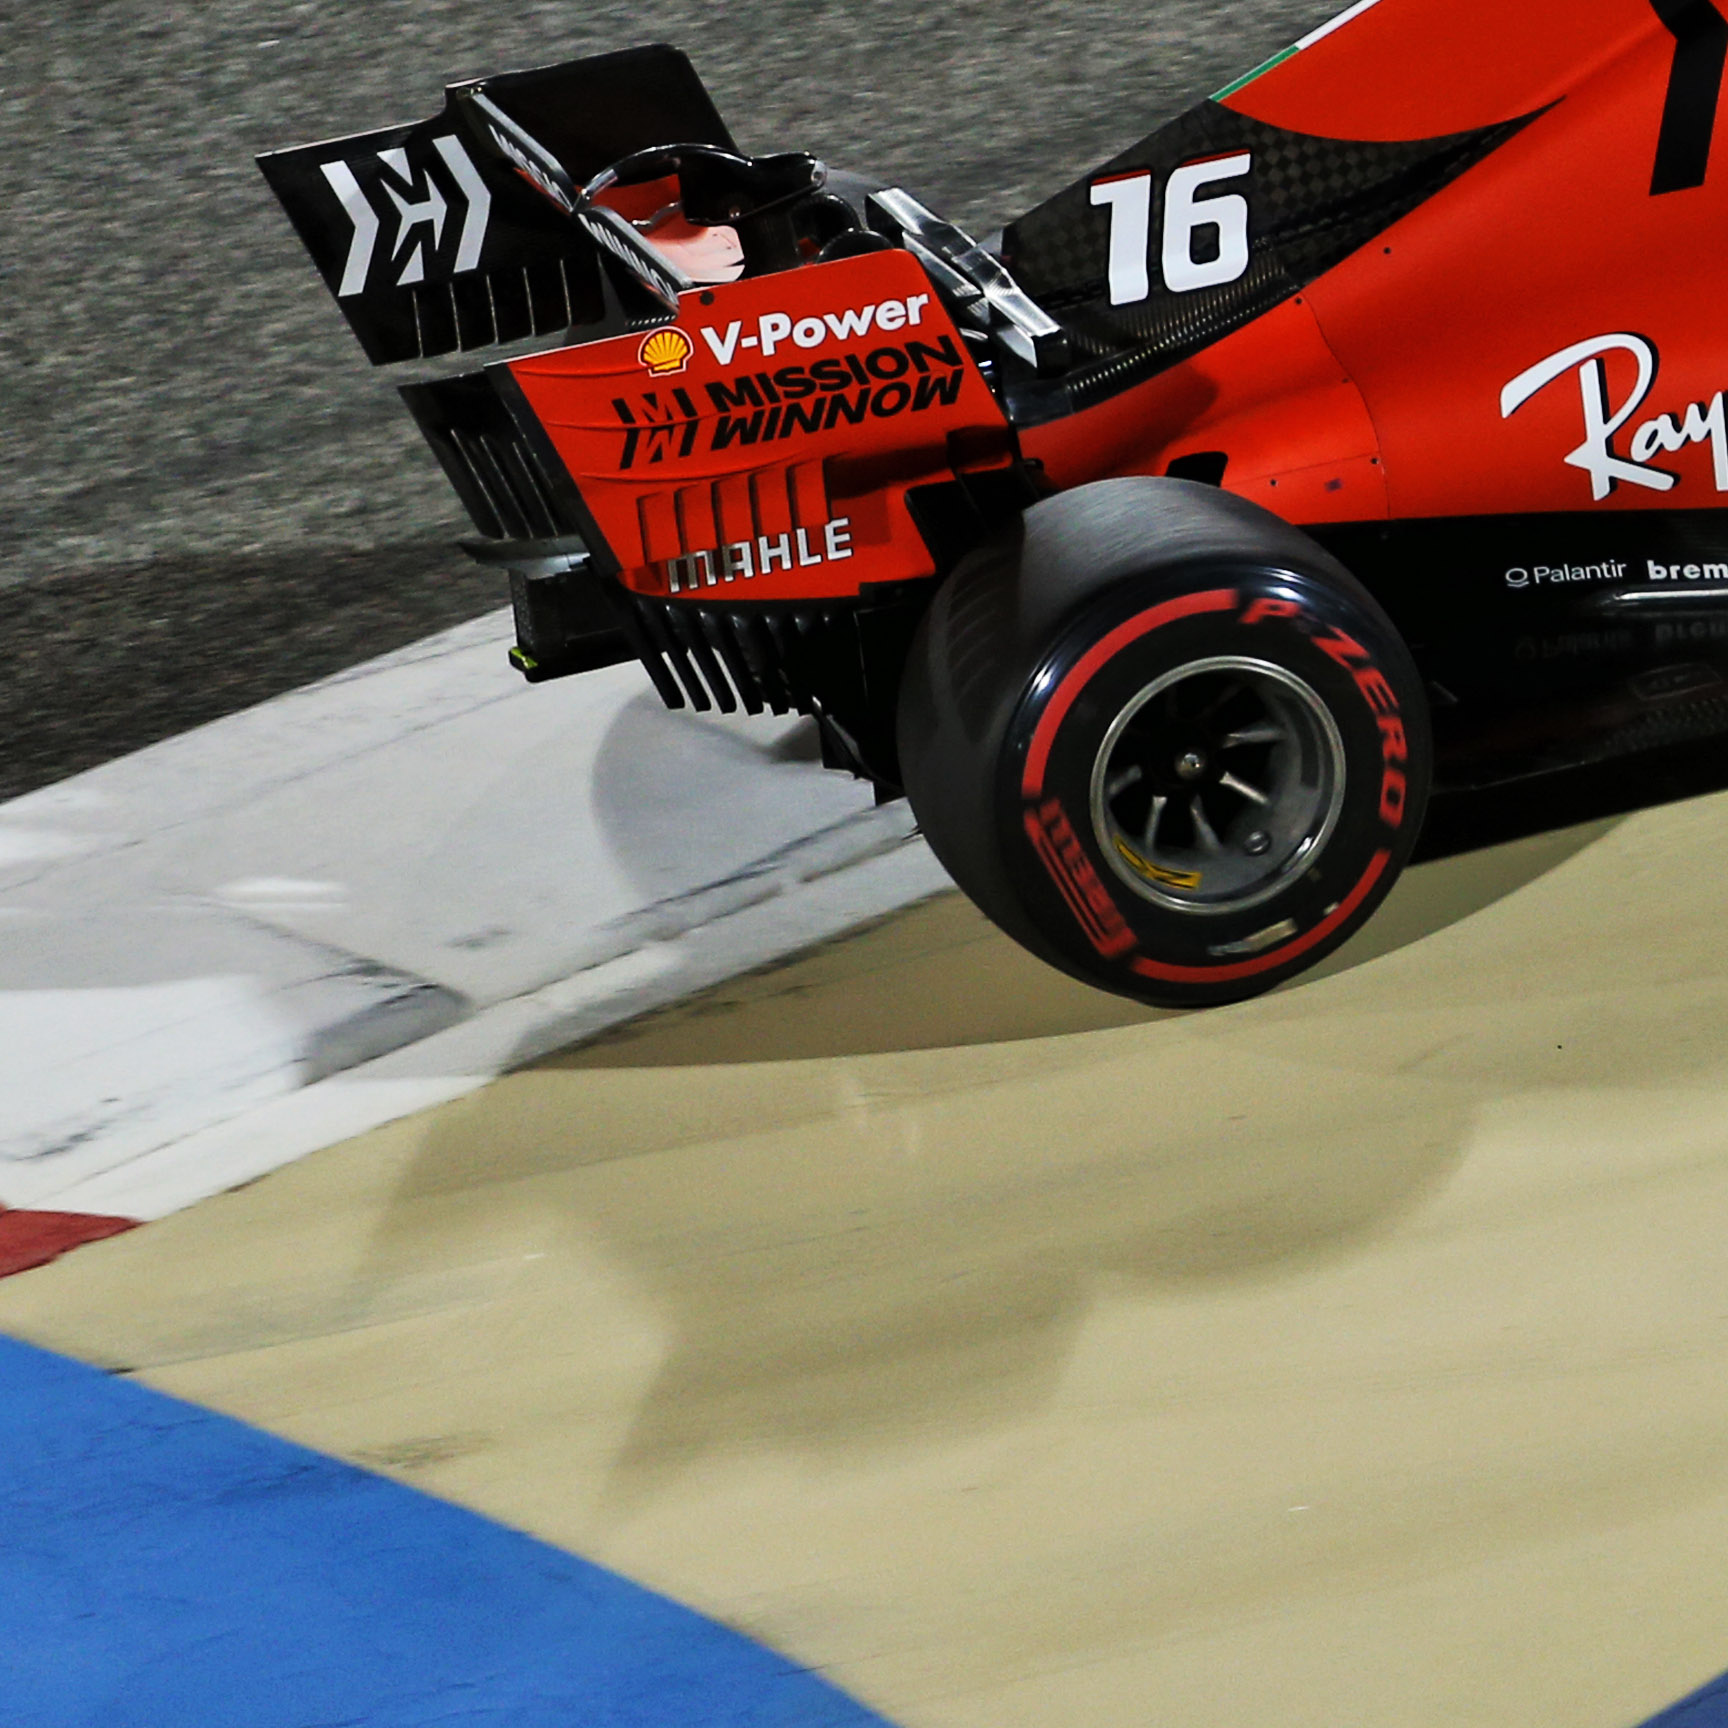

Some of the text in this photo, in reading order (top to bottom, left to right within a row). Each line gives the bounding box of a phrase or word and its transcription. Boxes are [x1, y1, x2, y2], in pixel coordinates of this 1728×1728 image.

[1090, 151, 1251, 306] 16
[700, 293, 930, 365] V-Power
[705, 335, 964, 412] MISSION
[711, 368, 964, 451] WINNOW
[667, 518, 852, 593] MAHLE
[1533, 559, 1627, 584] Palantir
[1310, 626, 1408, 829] ZERO
